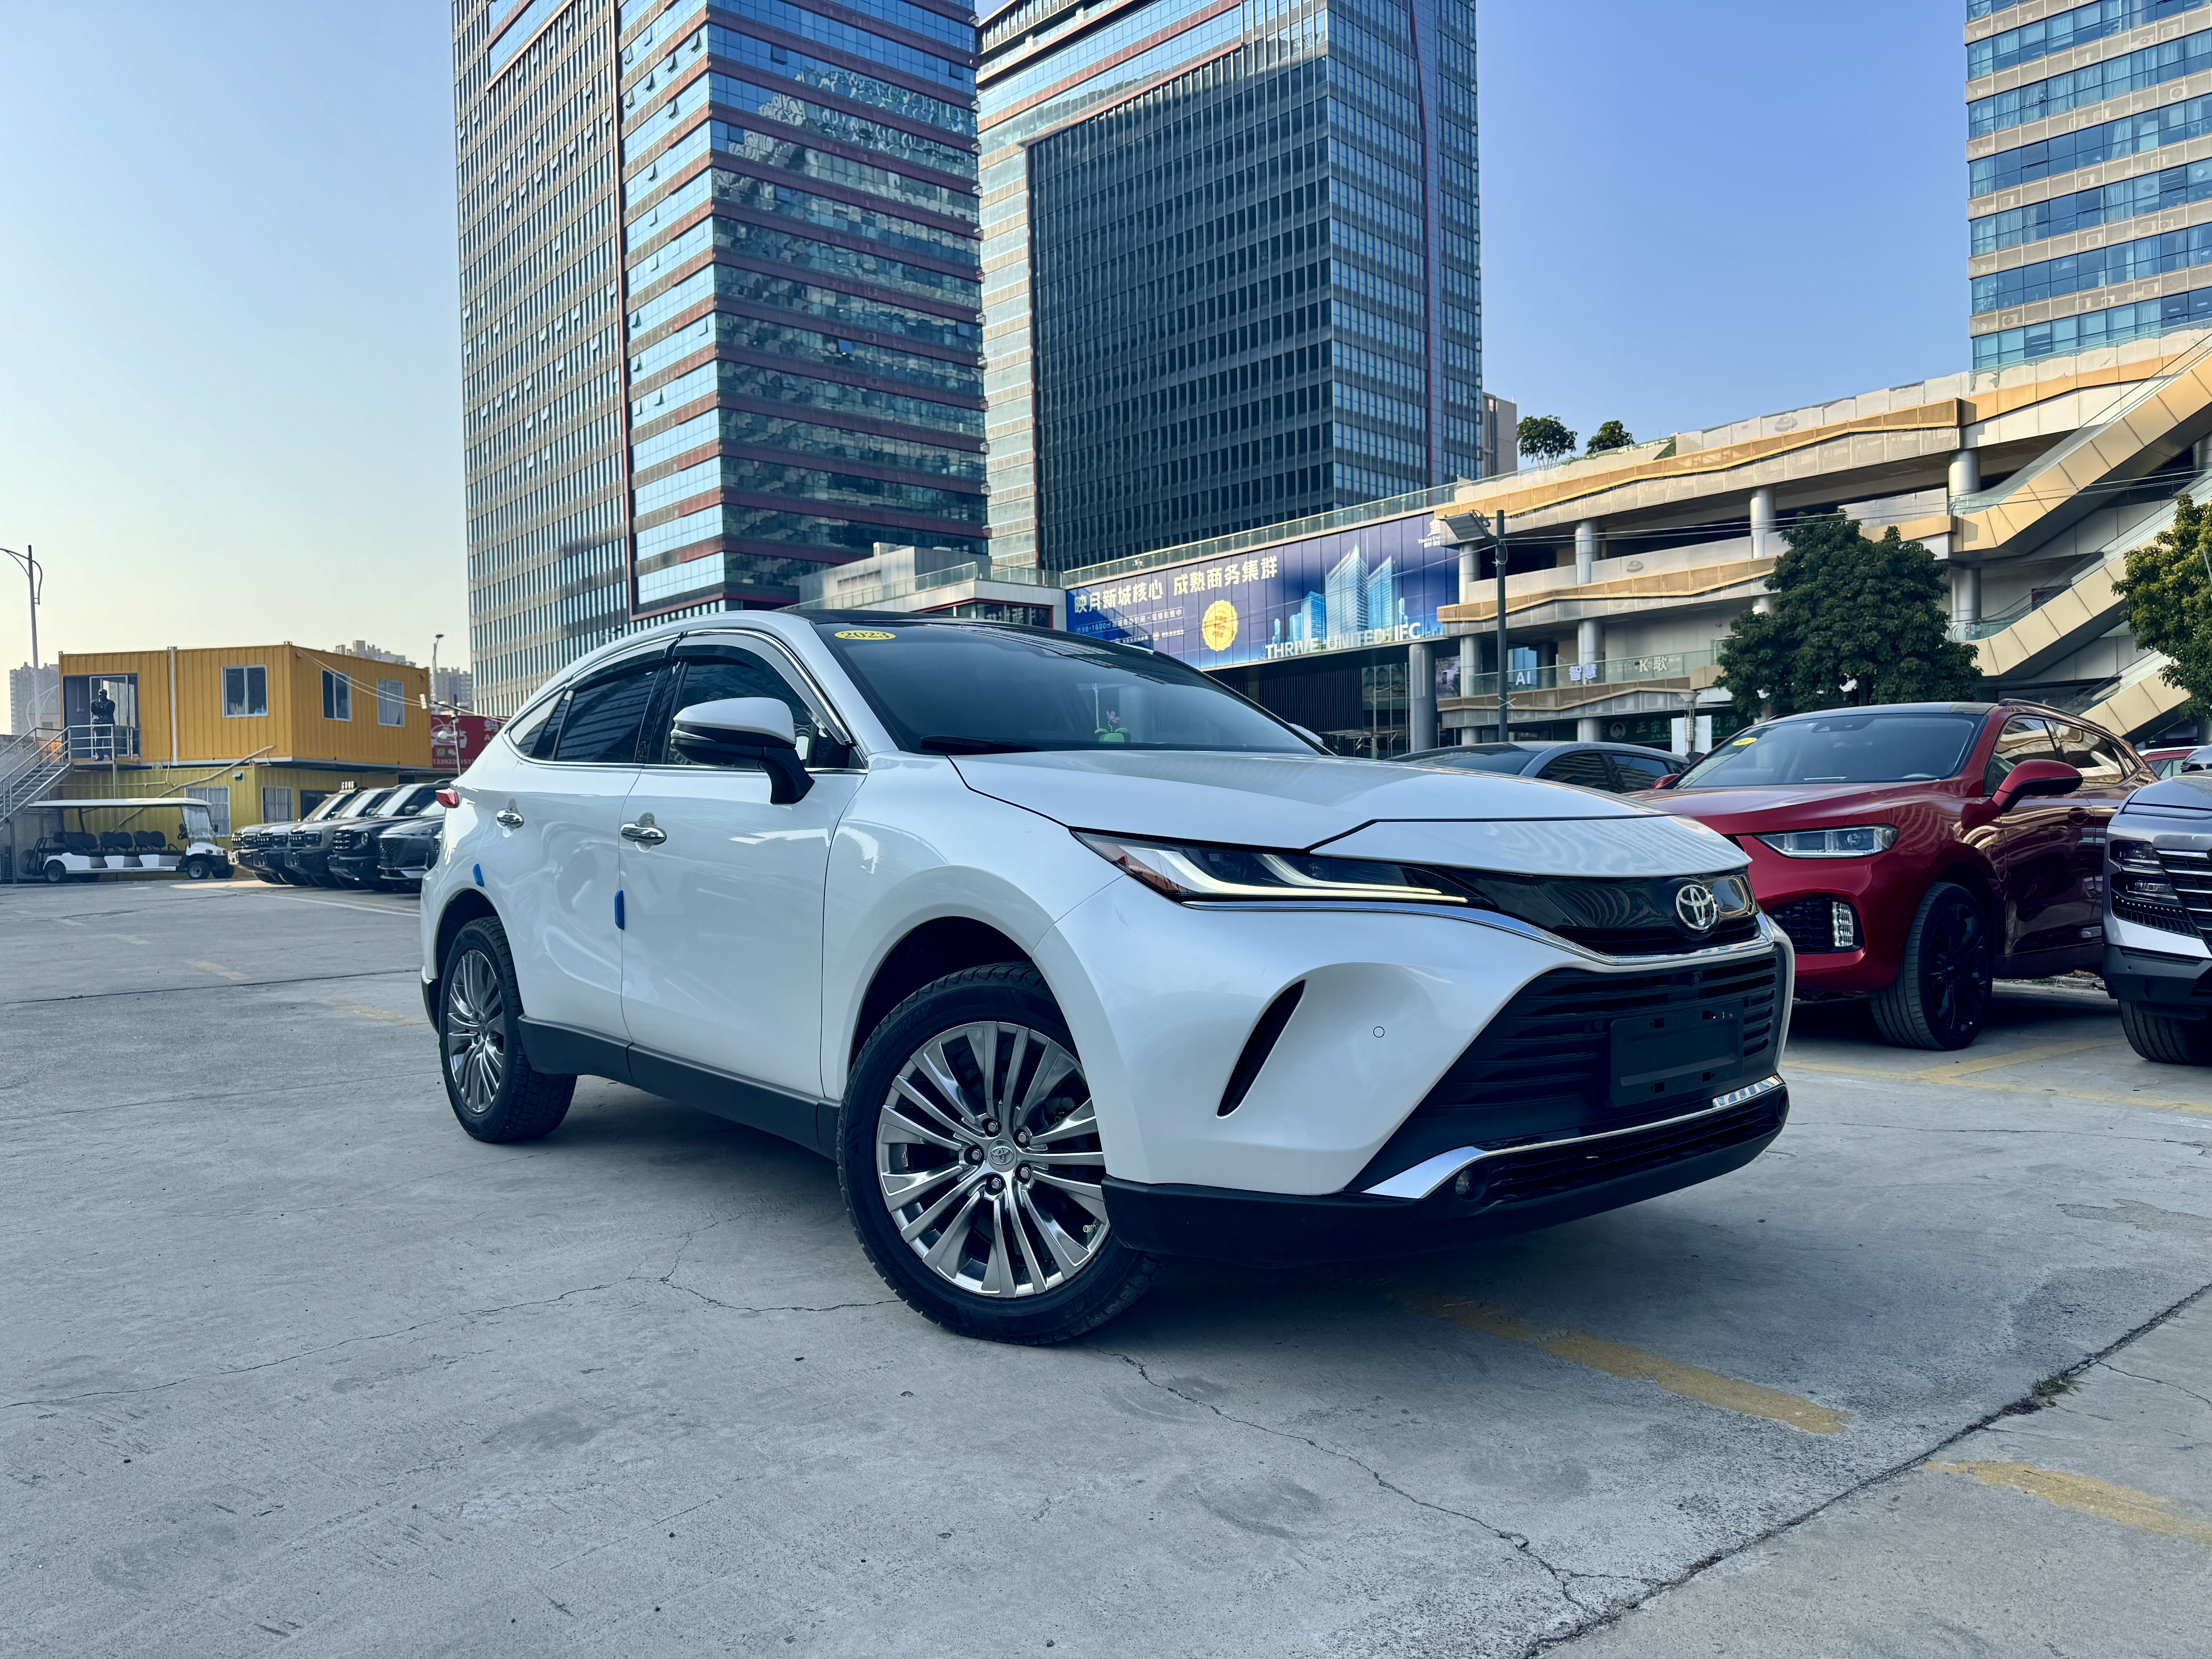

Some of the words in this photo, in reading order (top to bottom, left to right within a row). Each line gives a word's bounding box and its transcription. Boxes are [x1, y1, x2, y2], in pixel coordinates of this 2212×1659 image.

[1074, 579, 1163, 613] 映月新城核心
[1173, 555, 1278, 596] 成熟商务集群
[1265, 637, 1319, 659] THRIVE
[1326, 628, 1382, 651] UNITED
[1395, 622, 1420, 641] IFC
[1515, 671, 1530, 685] AI
[1569, 663, 1597, 681] 智慧
